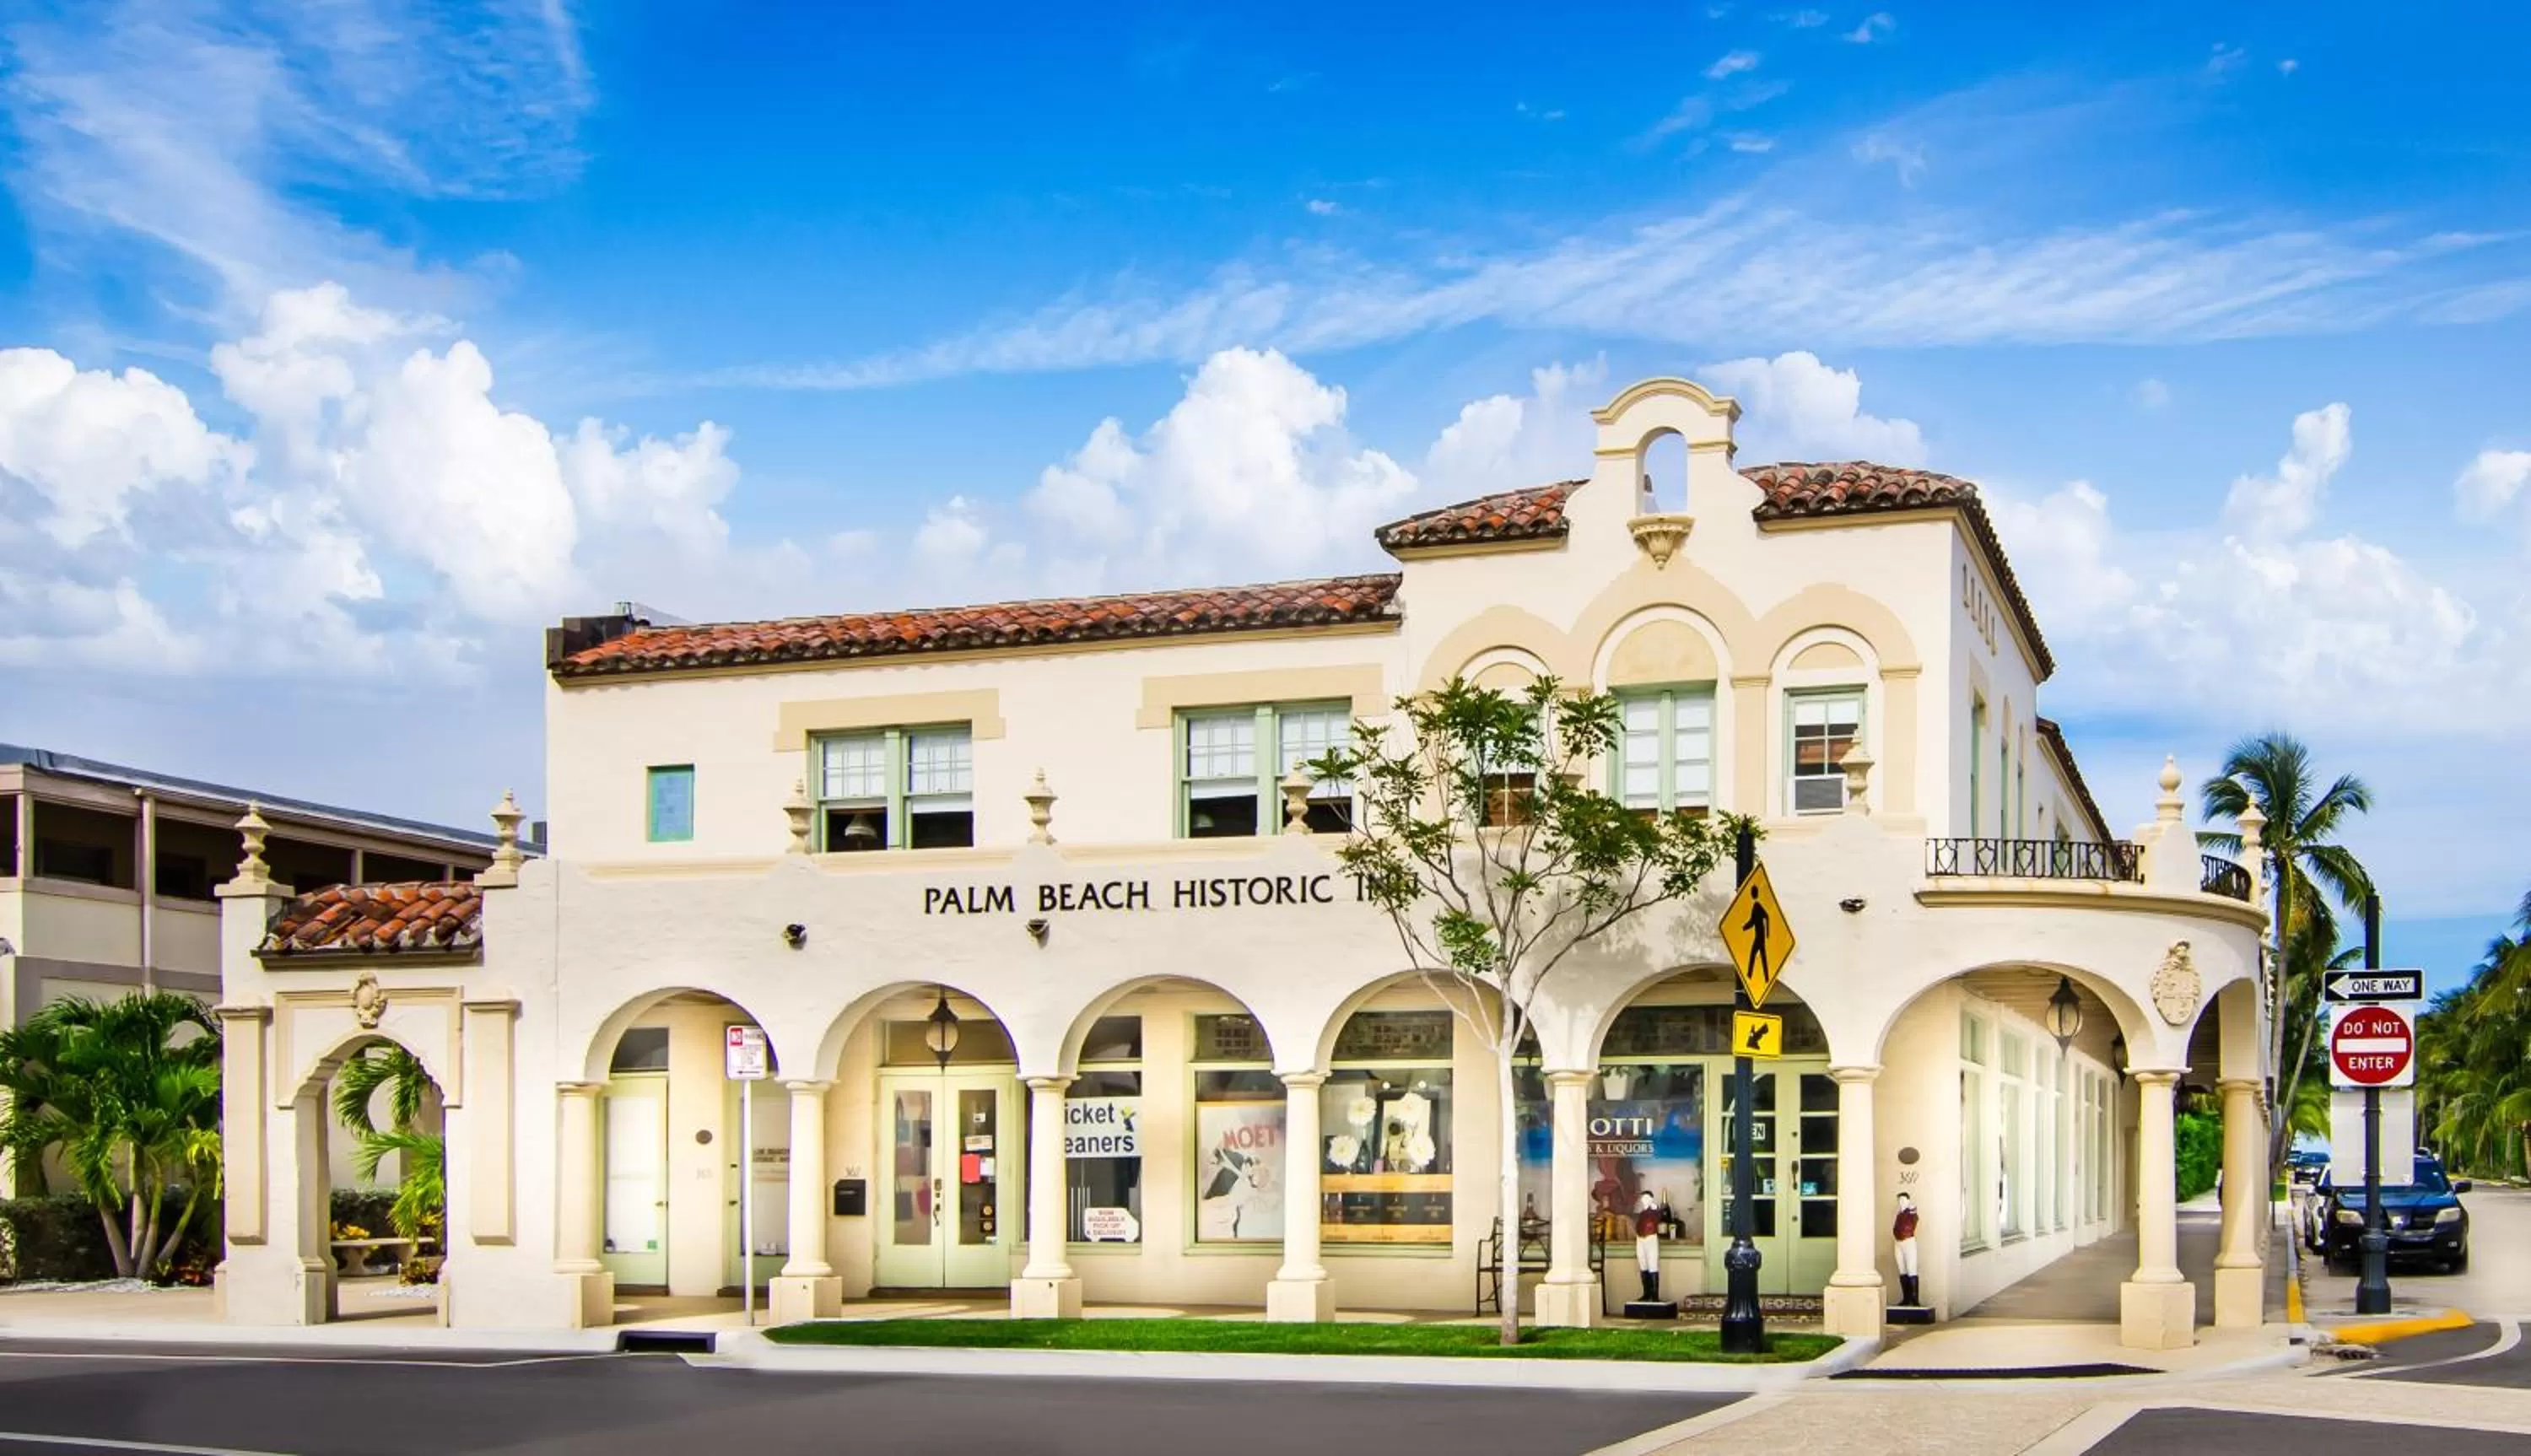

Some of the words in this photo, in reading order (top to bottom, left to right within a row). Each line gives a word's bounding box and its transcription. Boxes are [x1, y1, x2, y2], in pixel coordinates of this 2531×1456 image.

[924, 885, 1015, 914] PALM
[1038, 881, 1150, 912] BEACH
[1174, 875, 1334, 909] HISTORIC
[2351, 979, 2378, 993] ONE
[2383, 979, 2410, 992] WAY
[2343, 1021, 2363, 1035] DO
[2372, 1020, 2400, 1035] NOT
[2348, 1056, 2394, 1070] ENTER
[1064, 1102, 1115, 1124] icket
[1589, 1118, 1654, 1136] OTTI
[1064, 1135, 1135, 1154] eaners
[1607, 1143, 1654, 1157] LIQUORS
